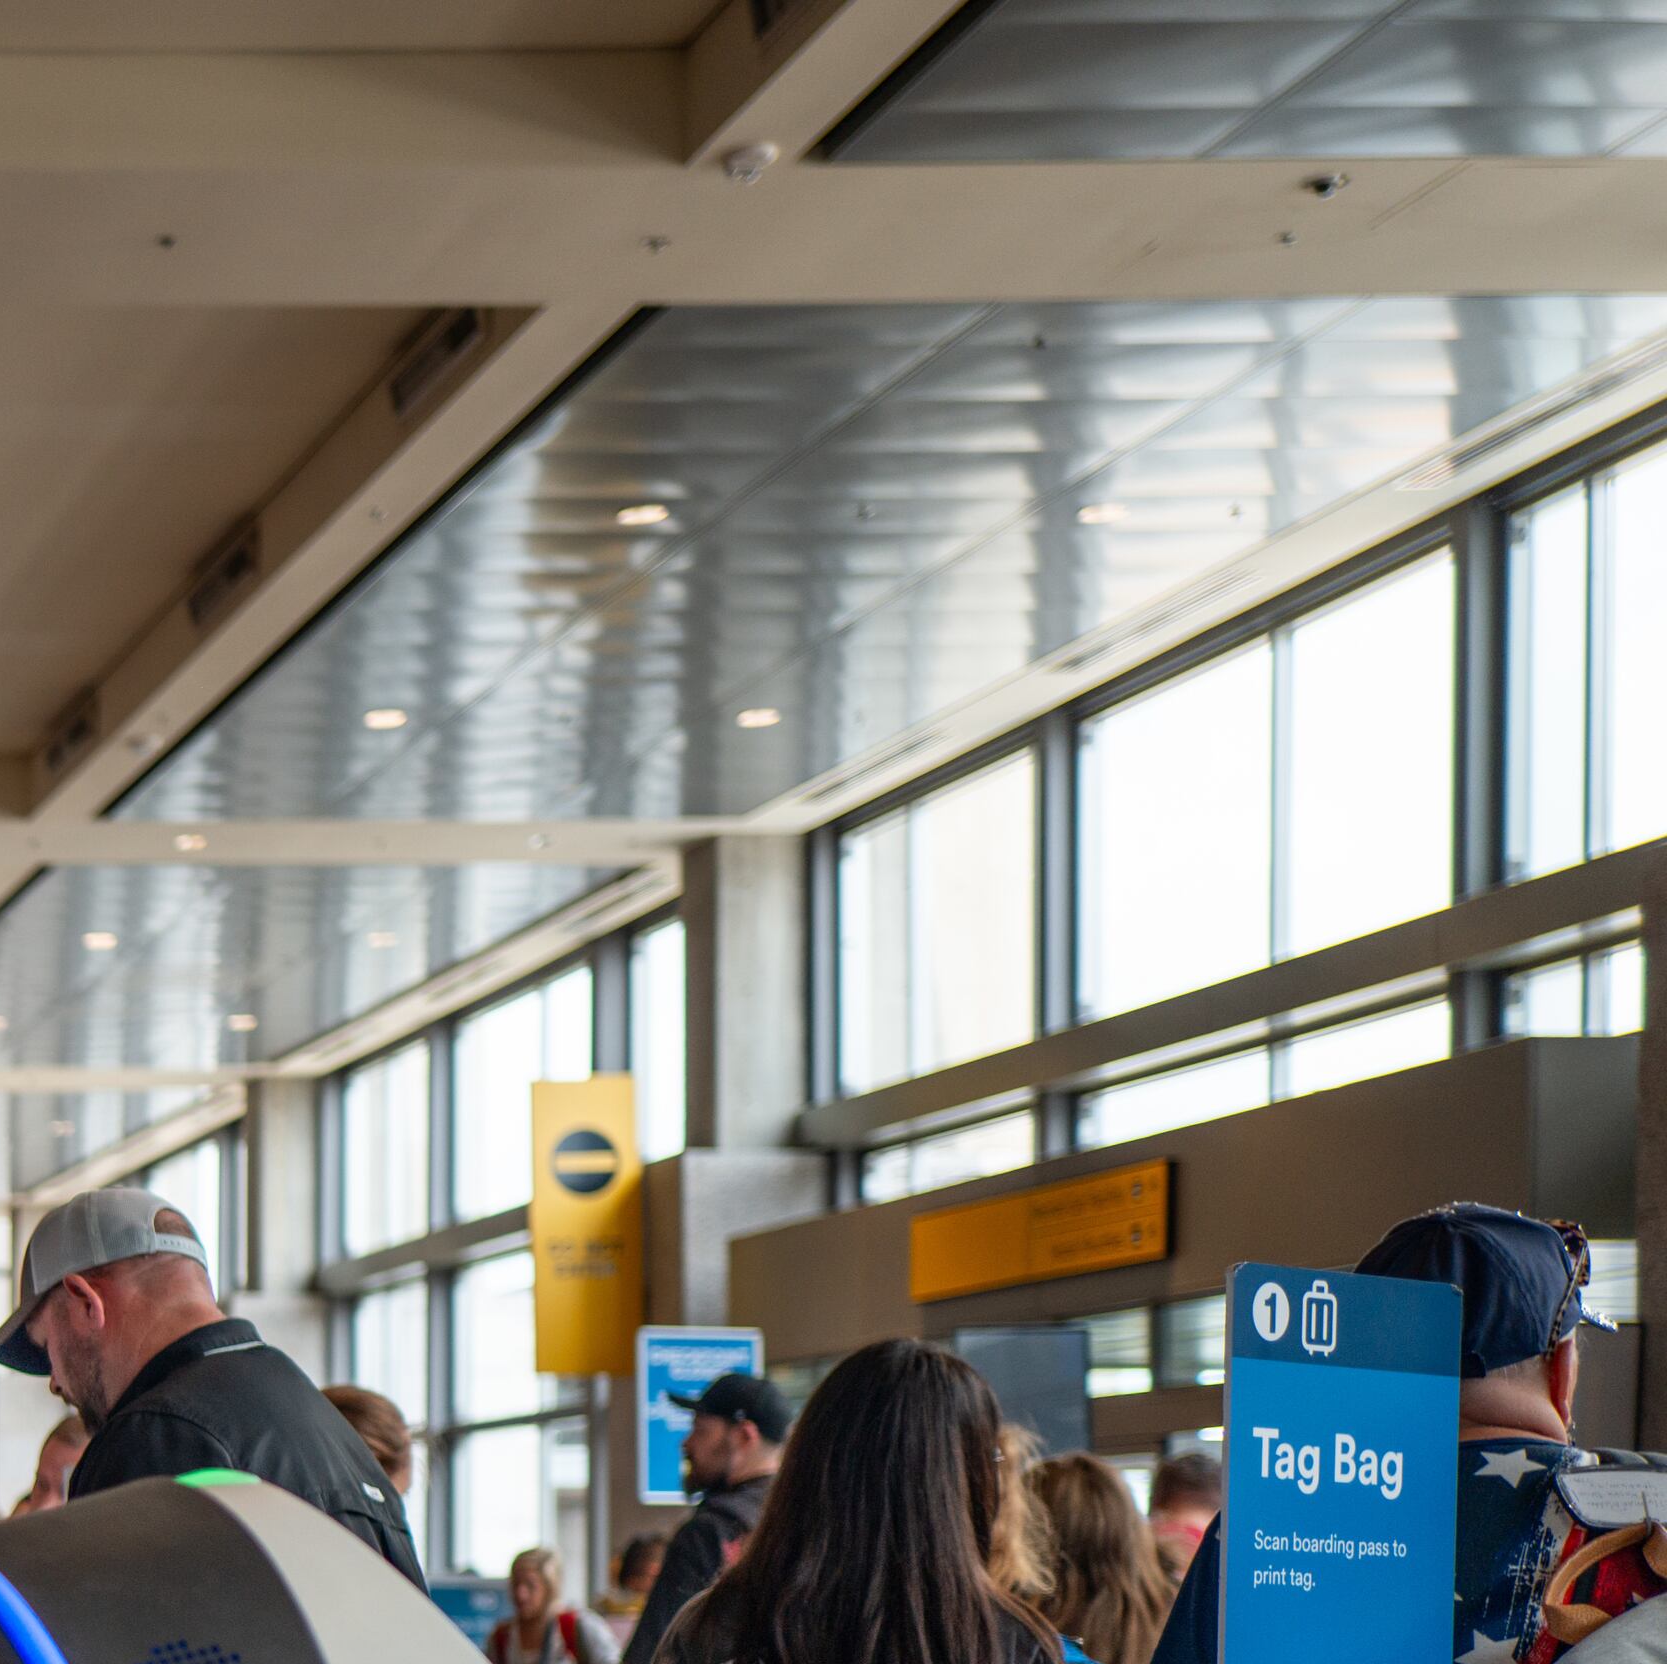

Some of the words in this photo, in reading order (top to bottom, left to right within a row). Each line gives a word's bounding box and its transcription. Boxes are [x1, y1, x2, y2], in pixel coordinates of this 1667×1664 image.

[1252, 1427, 1320, 1494] Tag
[1334, 1433, 1404, 1500] Bag
[1254, 1529, 1289, 1552] Scan
[1292, 1531, 1354, 1559] boarding
[1358, 1539, 1389, 1560] pass
[1393, 1538, 1407, 1557] to
[1253, 1565, 1286, 1588] print
[1289, 1568, 1316, 1592] tag.
